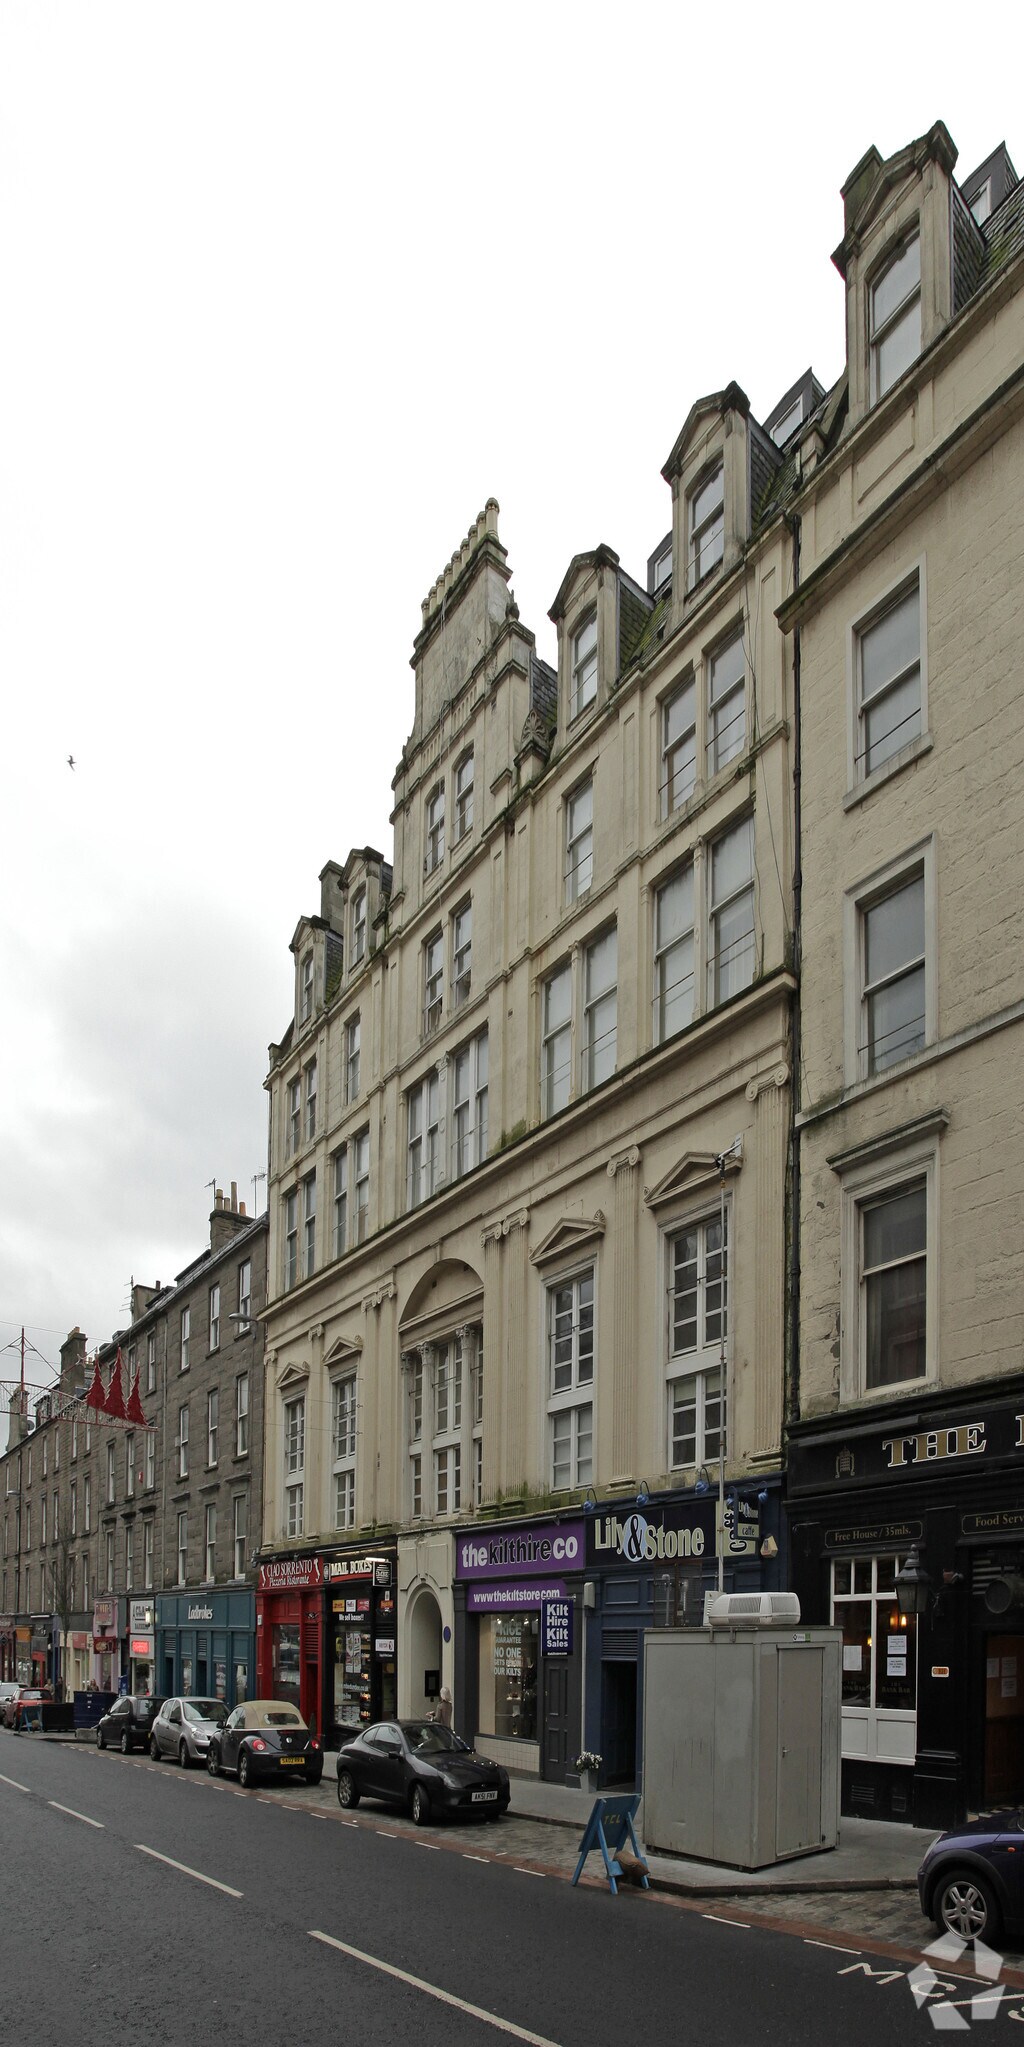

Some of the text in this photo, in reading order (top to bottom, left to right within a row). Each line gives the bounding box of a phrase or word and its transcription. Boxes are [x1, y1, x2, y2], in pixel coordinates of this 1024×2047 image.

[882, 1422, 987, 1467] THE
[976, 1515, 999, 1527] Food
[835, 1532, 851, 1541] Free
[852, 1529, 878, 1540] House
[266, 1563, 281, 1578] CIAO
[280, 1559, 313, 1577] SORRENTO
[331, 1562, 349, 1576] MAIL
[350, 1559, 373, 1574] BOXES
[188, 1604, 213, 1620] Ladbrokes
[547, 1603, 569, 1616] Kilt
[546, 1616, 569, 1626] Hire
[546, 1628, 569, 1640] Kilt
[546, 1640, 569, 1648] Sales
[494, 1647, 522, 1658] NO ONE
